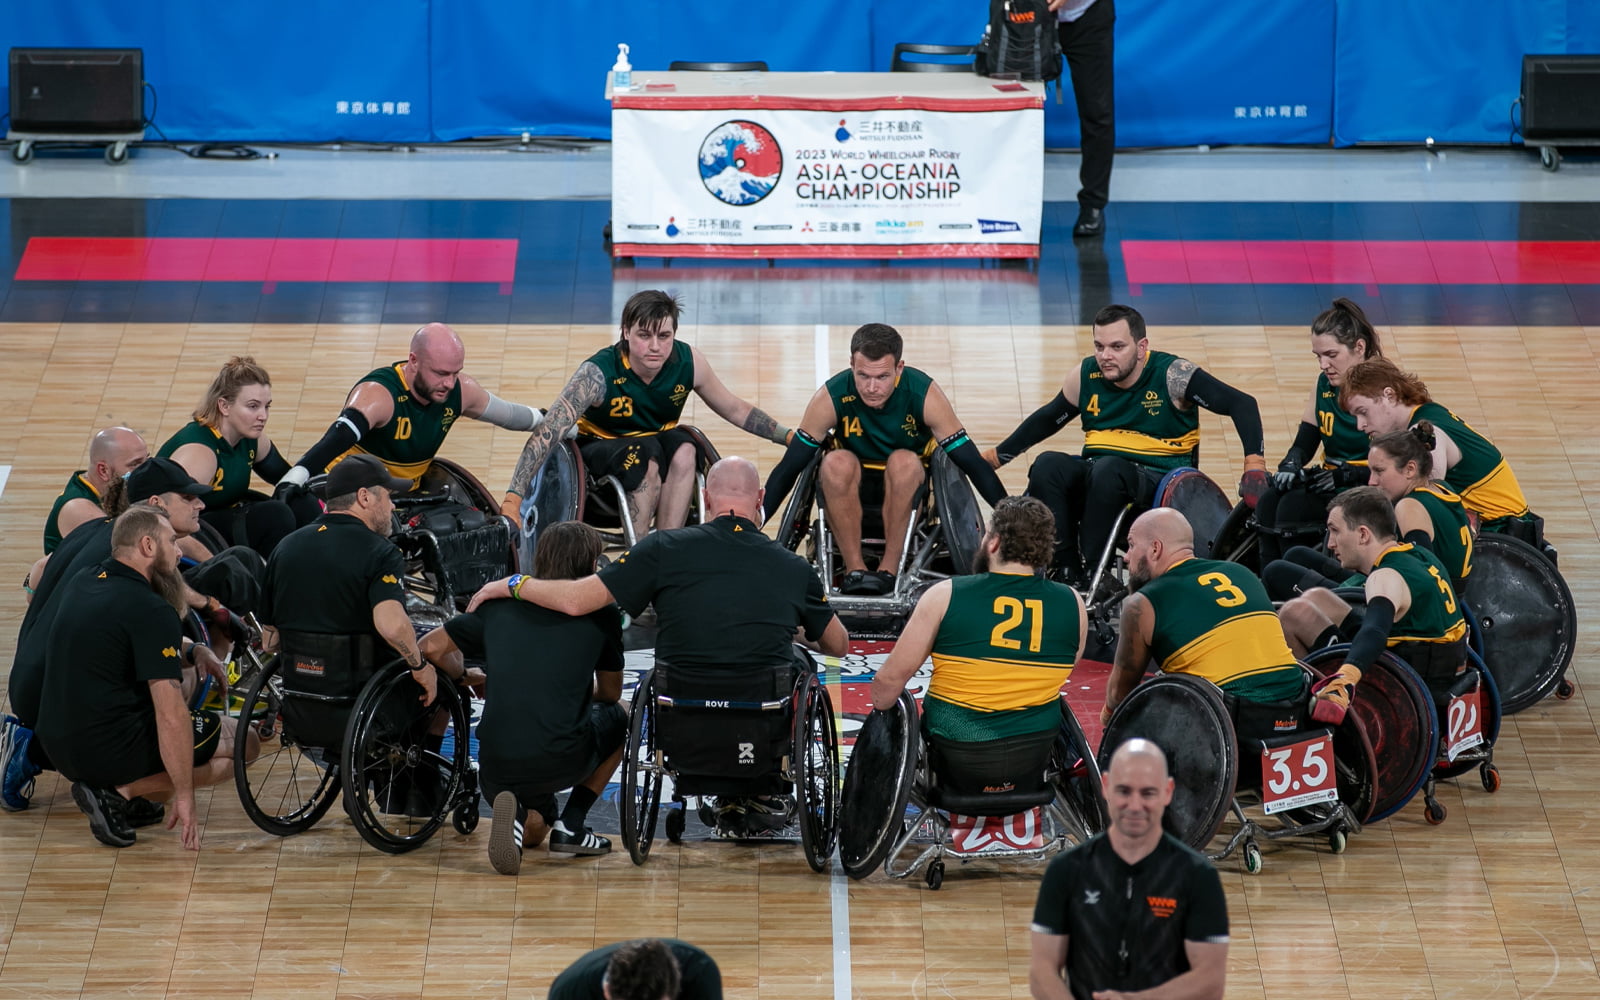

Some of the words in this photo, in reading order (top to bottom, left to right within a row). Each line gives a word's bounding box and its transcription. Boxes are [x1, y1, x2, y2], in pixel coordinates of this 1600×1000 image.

[859, 121, 923, 132] 三井不動産
[796, 150, 826, 159] 2023
[796, 163, 961, 181] ASIA-OCEANIA
[796, 182, 961, 201] CHAMPIONSHIP
[687, 218, 743, 230] 三井不動産
[609, 396, 633, 417] 23
[1086, 393, 1101, 416] 4
[394, 416, 412, 440] 10
[842, 415, 863, 438] 14
[623, 453, 636, 471] AUS
[1460, 524, 1473, 578] 2
[1197, 572, 1247, 608] 3
[1428, 565, 1456, 615] 5
[990, 595, 1043, 653] 21
[705, 700, 730, 708] ROVE
[195, 716, 204, 734] AUS
[1268, 741, 1328, 795] 3.5
[957, 809, 1035, 851] 2.0
